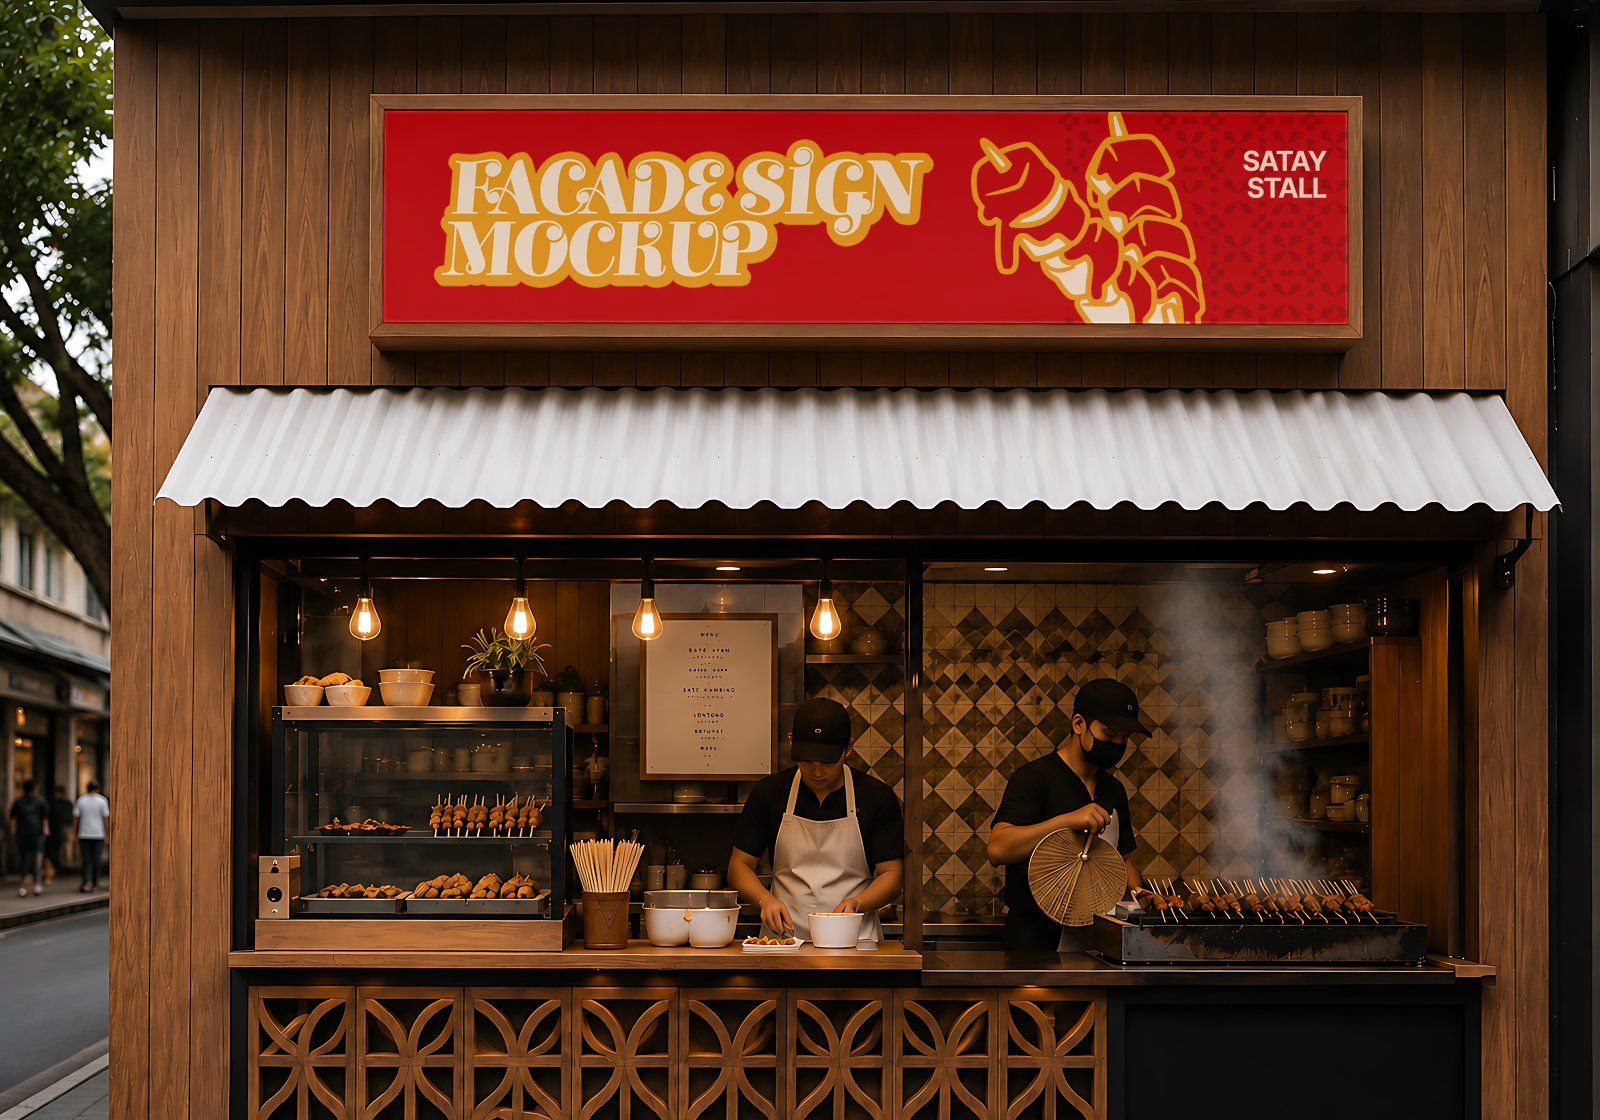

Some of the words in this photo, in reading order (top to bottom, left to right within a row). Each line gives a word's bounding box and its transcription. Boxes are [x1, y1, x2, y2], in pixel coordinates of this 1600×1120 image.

[1242, 149, 1328, 172] SATAY
[451, 157, 726, 216] FACADE
[1247, 176, 1328, 199] STALL
[441, 219, 769, 278] MOCKUP
